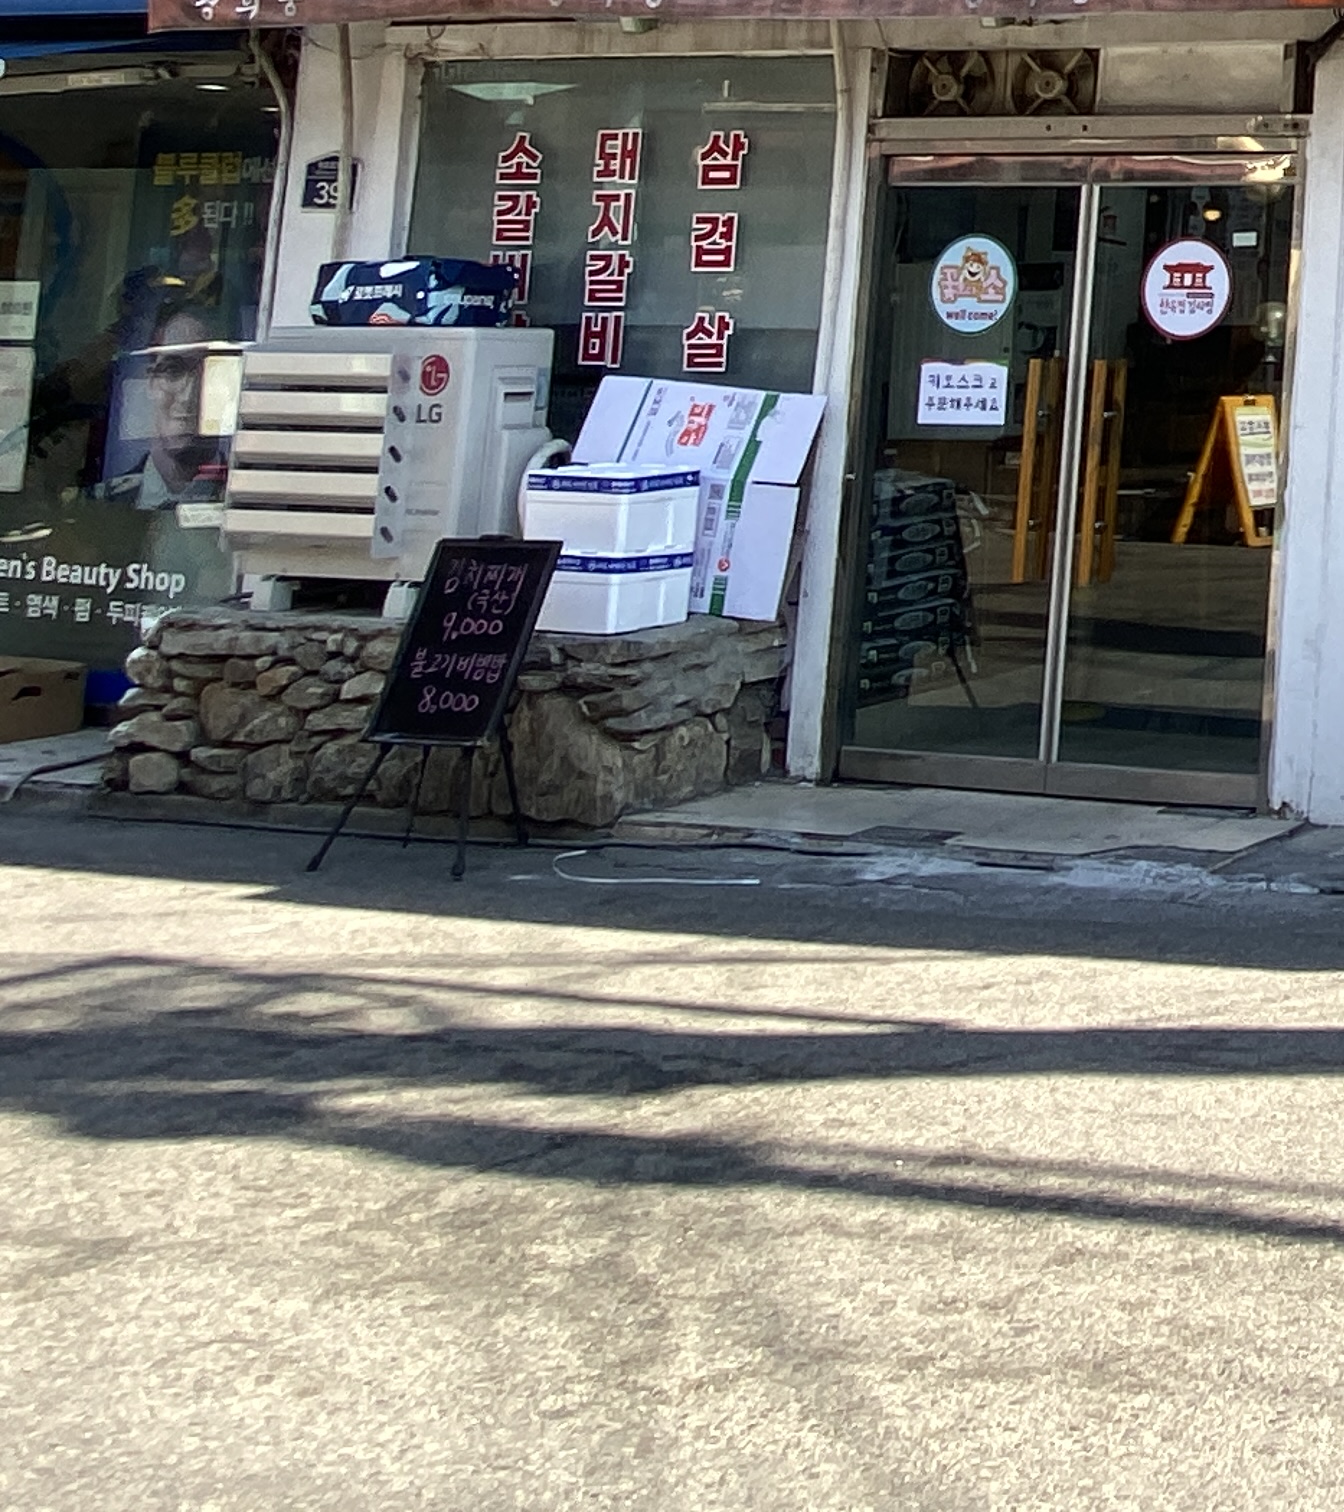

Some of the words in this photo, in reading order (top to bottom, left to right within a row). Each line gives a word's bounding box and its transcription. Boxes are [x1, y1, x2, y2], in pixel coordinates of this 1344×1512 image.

[489, 131, 541, 328] 소갈비
[577, 127, 643, 368] 돼지갈비
[682, 130, 749, 372] 삼겹살
[415, 403, 442, 425] LG
[41, 555, 122, 595] Beauty
[125, 561, 186, 599] Shop
[417, 684, 480, 714] 8,000
